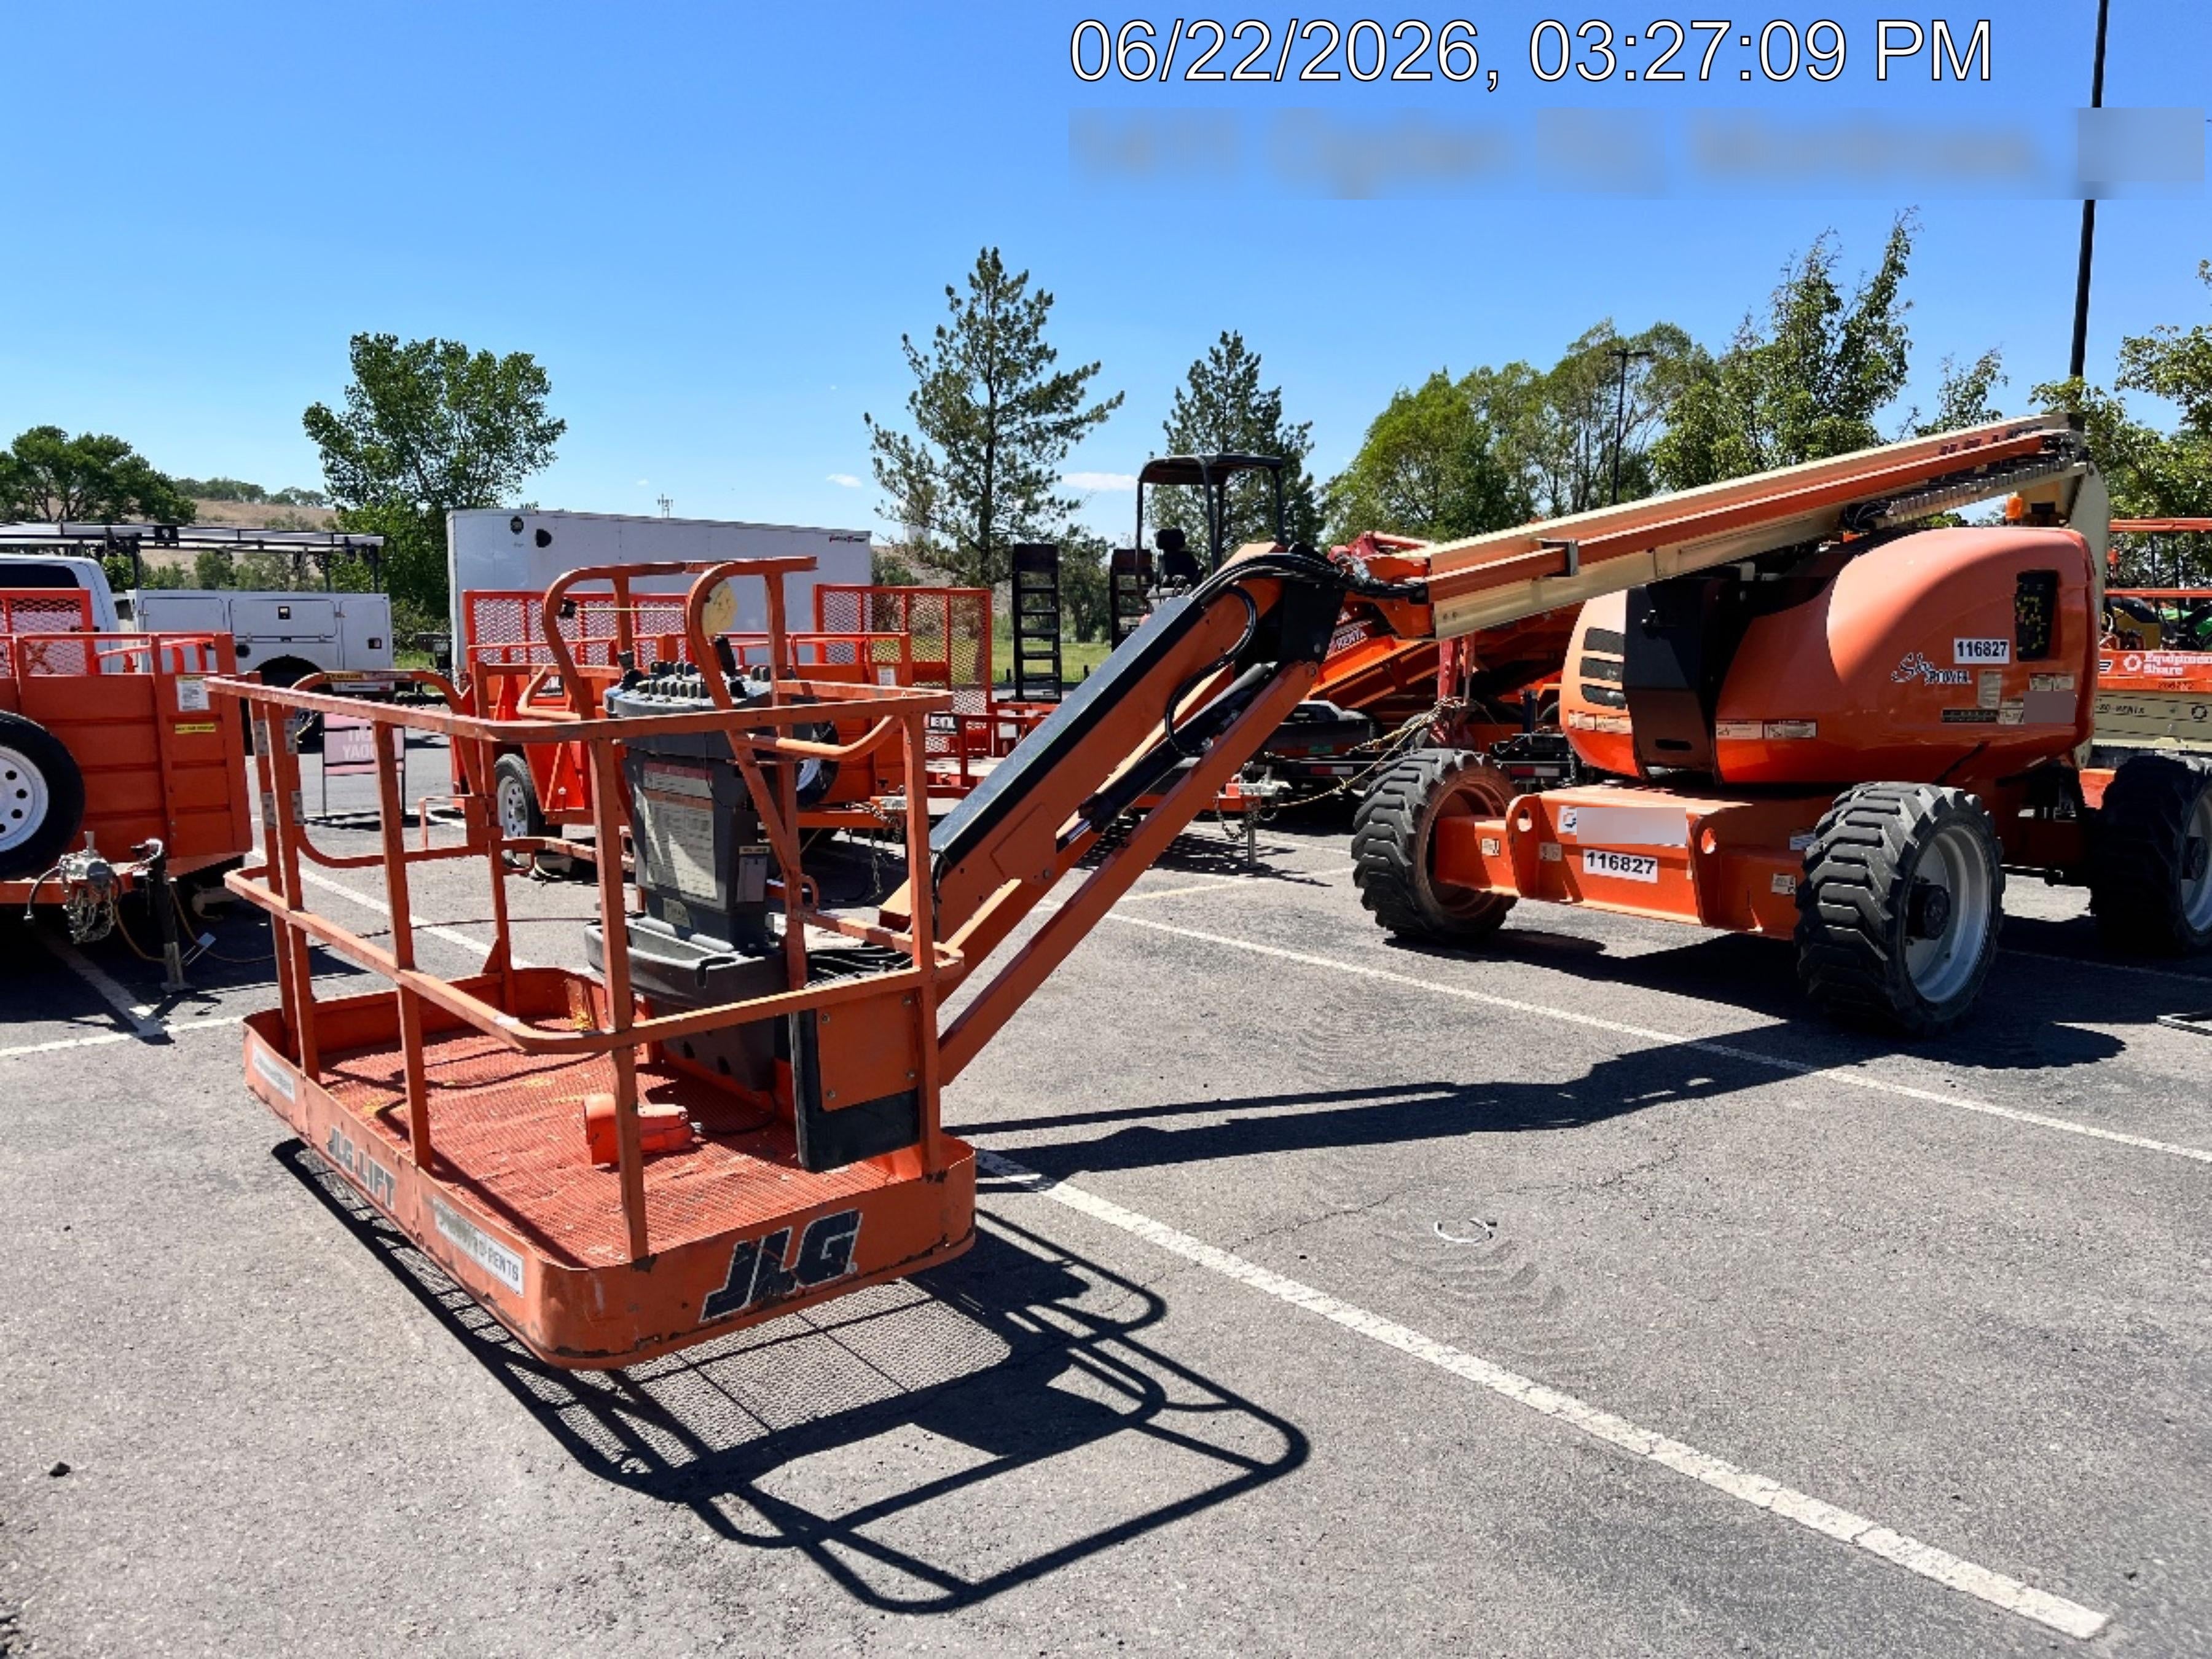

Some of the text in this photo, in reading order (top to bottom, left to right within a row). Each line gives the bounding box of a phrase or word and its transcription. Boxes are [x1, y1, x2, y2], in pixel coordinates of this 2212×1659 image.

[1956, 641, 2008, 657] 116827
[1586, 851, 1656, 874] 116827
[357, 1149, 396, 1211] LIFT
[699, 1207, 863, 1323] JLG
